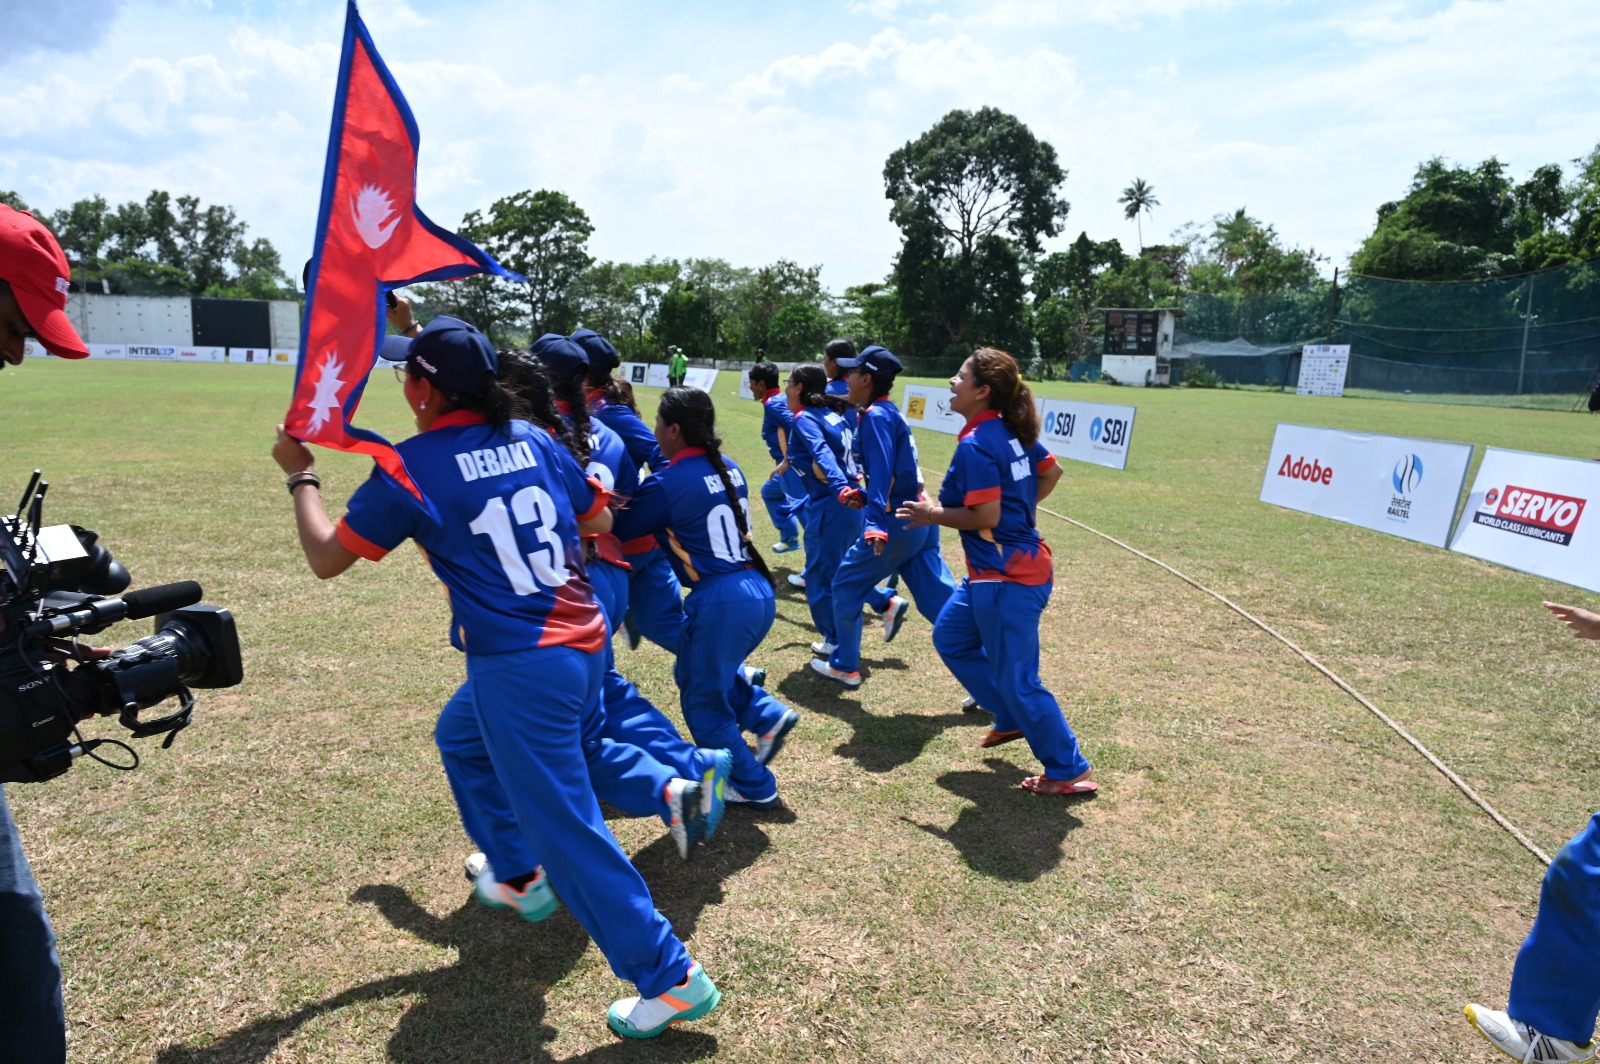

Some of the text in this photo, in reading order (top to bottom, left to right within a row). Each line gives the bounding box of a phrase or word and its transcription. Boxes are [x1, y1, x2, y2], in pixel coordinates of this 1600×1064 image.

[1054, 412, 1076, 437] SBI
[1102, 418, 1127, 446] SBI
[454, 441, 538, 482] DEBAKI
[1277, 454, 1333, 485] Adobe
[1387, 506, 1410, 519] RAILTEL
[1500, 489, 1579, 527] SERVO
[468, 485, 571, 596] 13
[1478, 514, 1566, 543] WORLD CLASS LUBRICANTS
